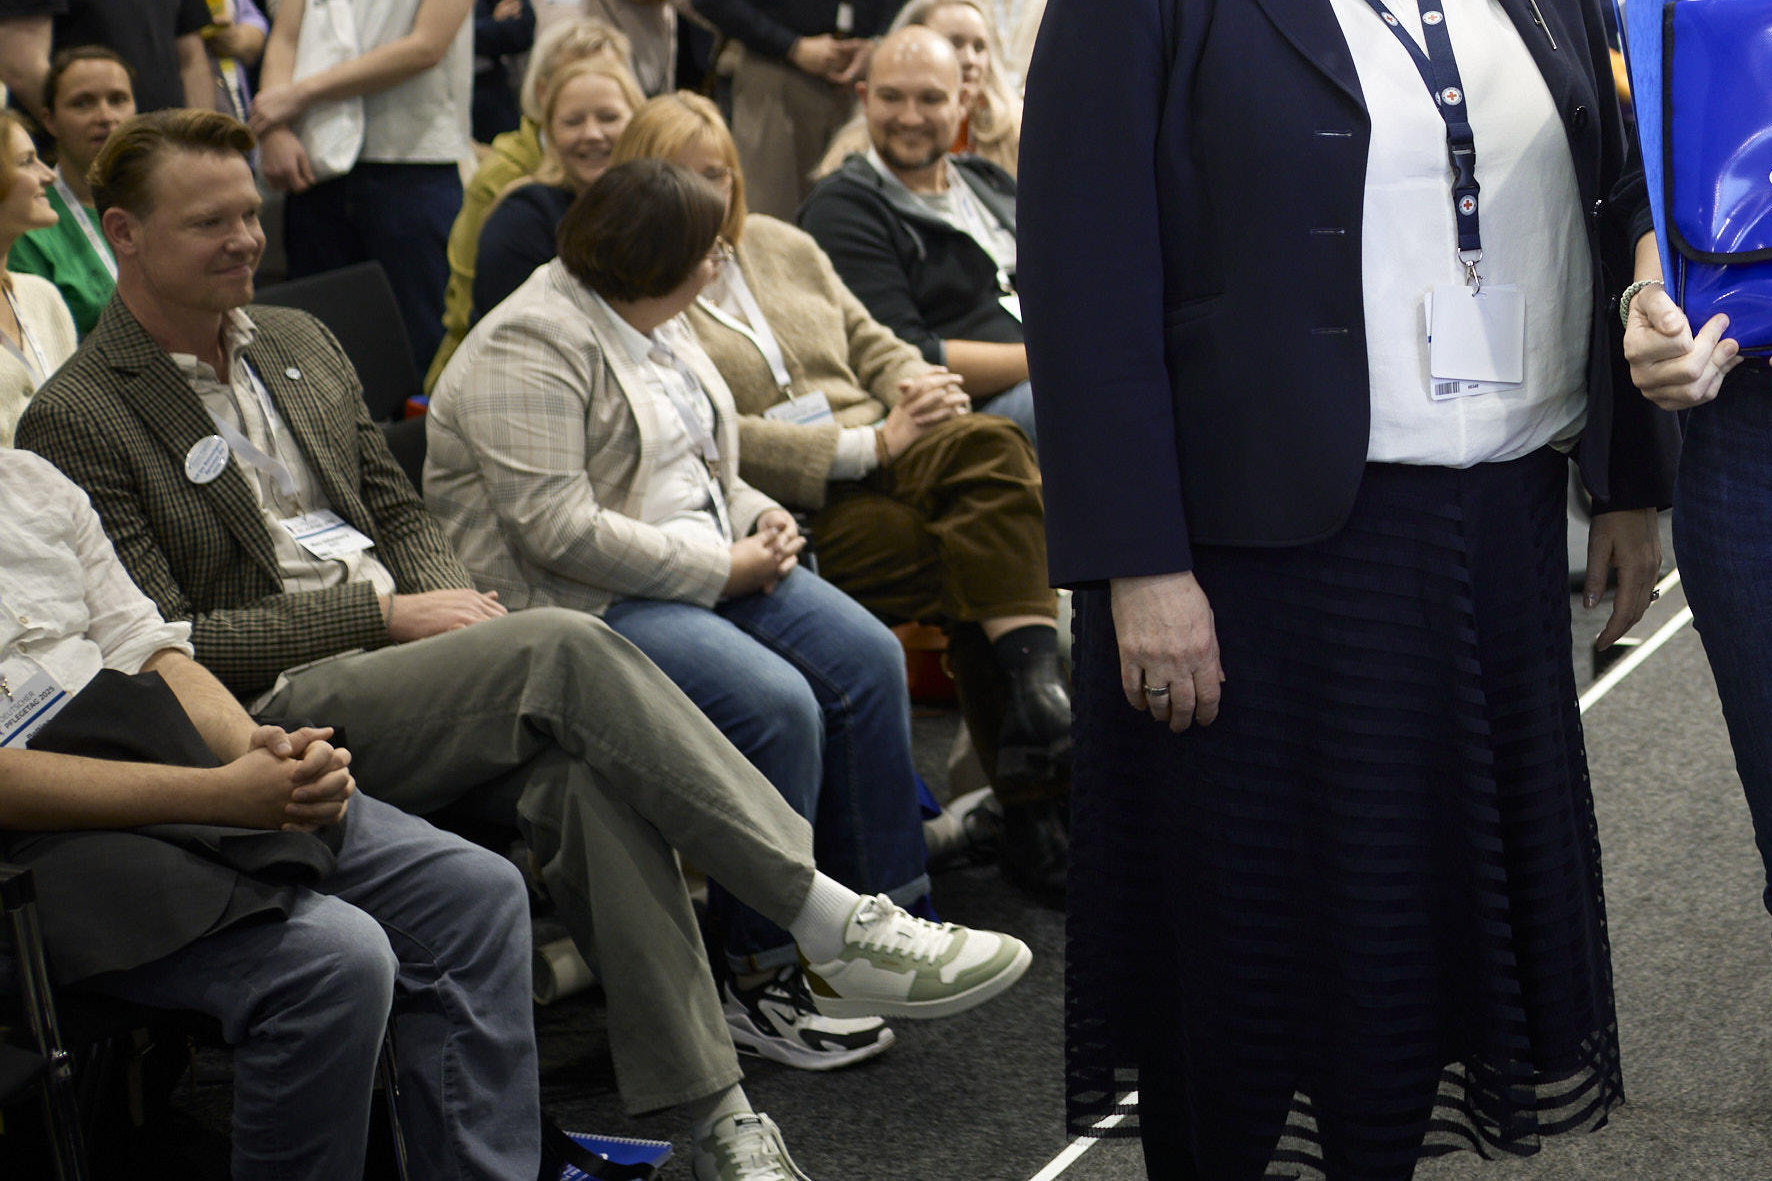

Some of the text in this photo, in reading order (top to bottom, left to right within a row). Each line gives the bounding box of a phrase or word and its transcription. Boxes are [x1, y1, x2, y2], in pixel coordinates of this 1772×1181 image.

[0, 691, 35, 722] DEUTSCHER
[4, 685, 55, 729] PFLEGETAG 2025
